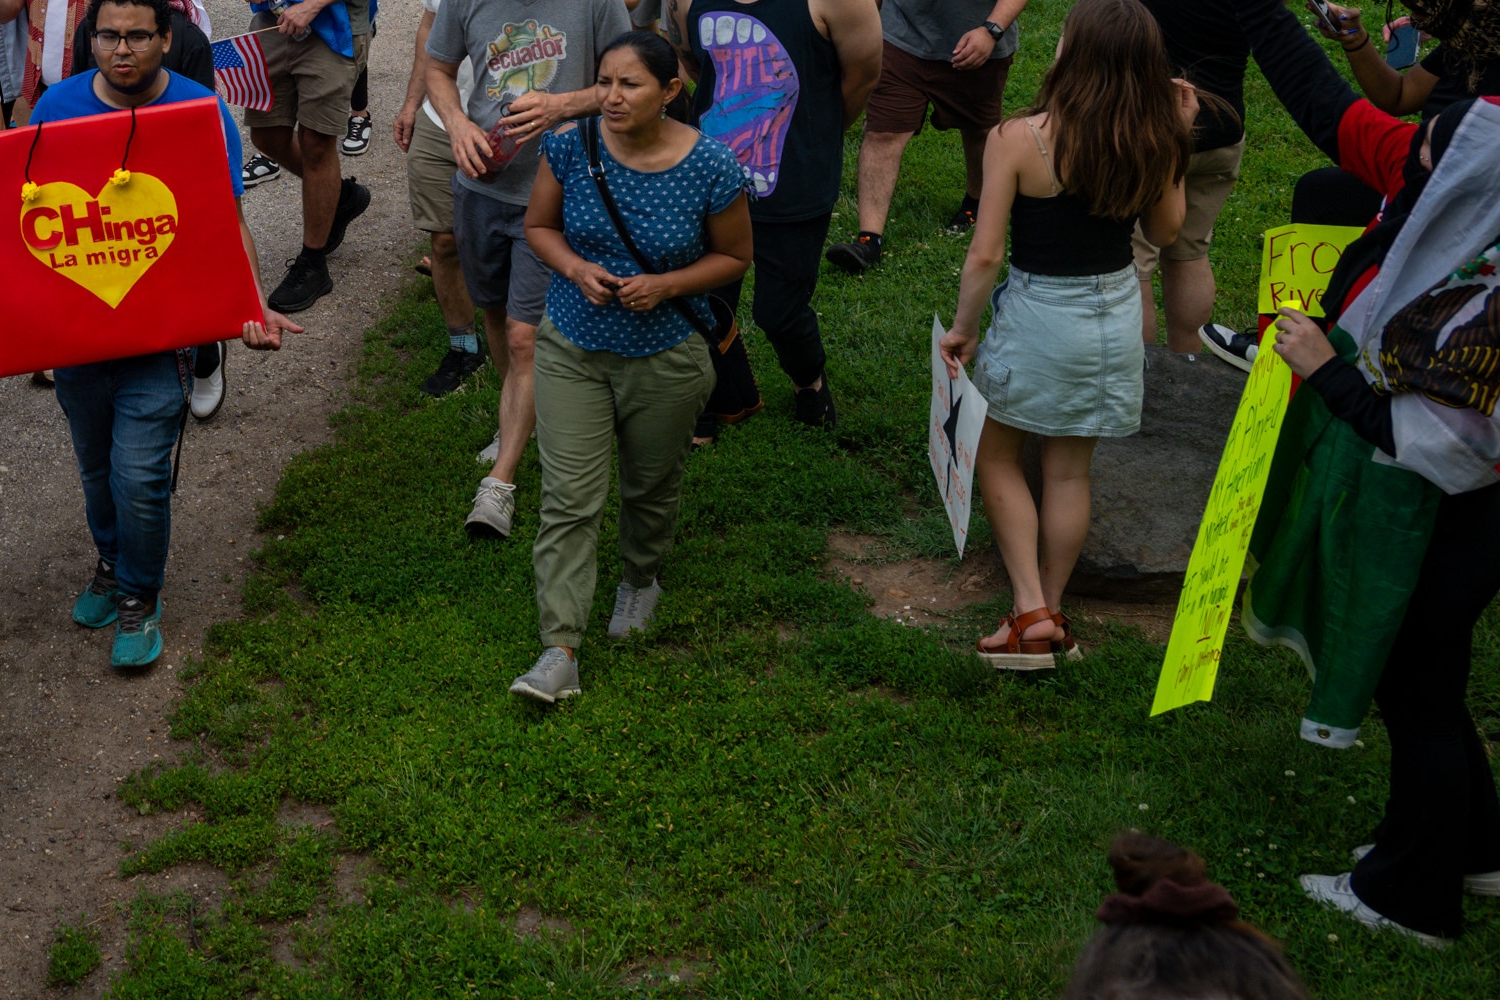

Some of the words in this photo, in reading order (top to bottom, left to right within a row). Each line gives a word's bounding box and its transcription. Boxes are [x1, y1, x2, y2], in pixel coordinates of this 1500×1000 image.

[488, 36, 566, 74] ecuador
[713, 43, 791, 96] TITLE
[21, 201, 178, 250] CHinga
[49, 252, 78, 269] La
[87, 245, 159, 267] migra
[1268, 230, 1341, 278] Fro
